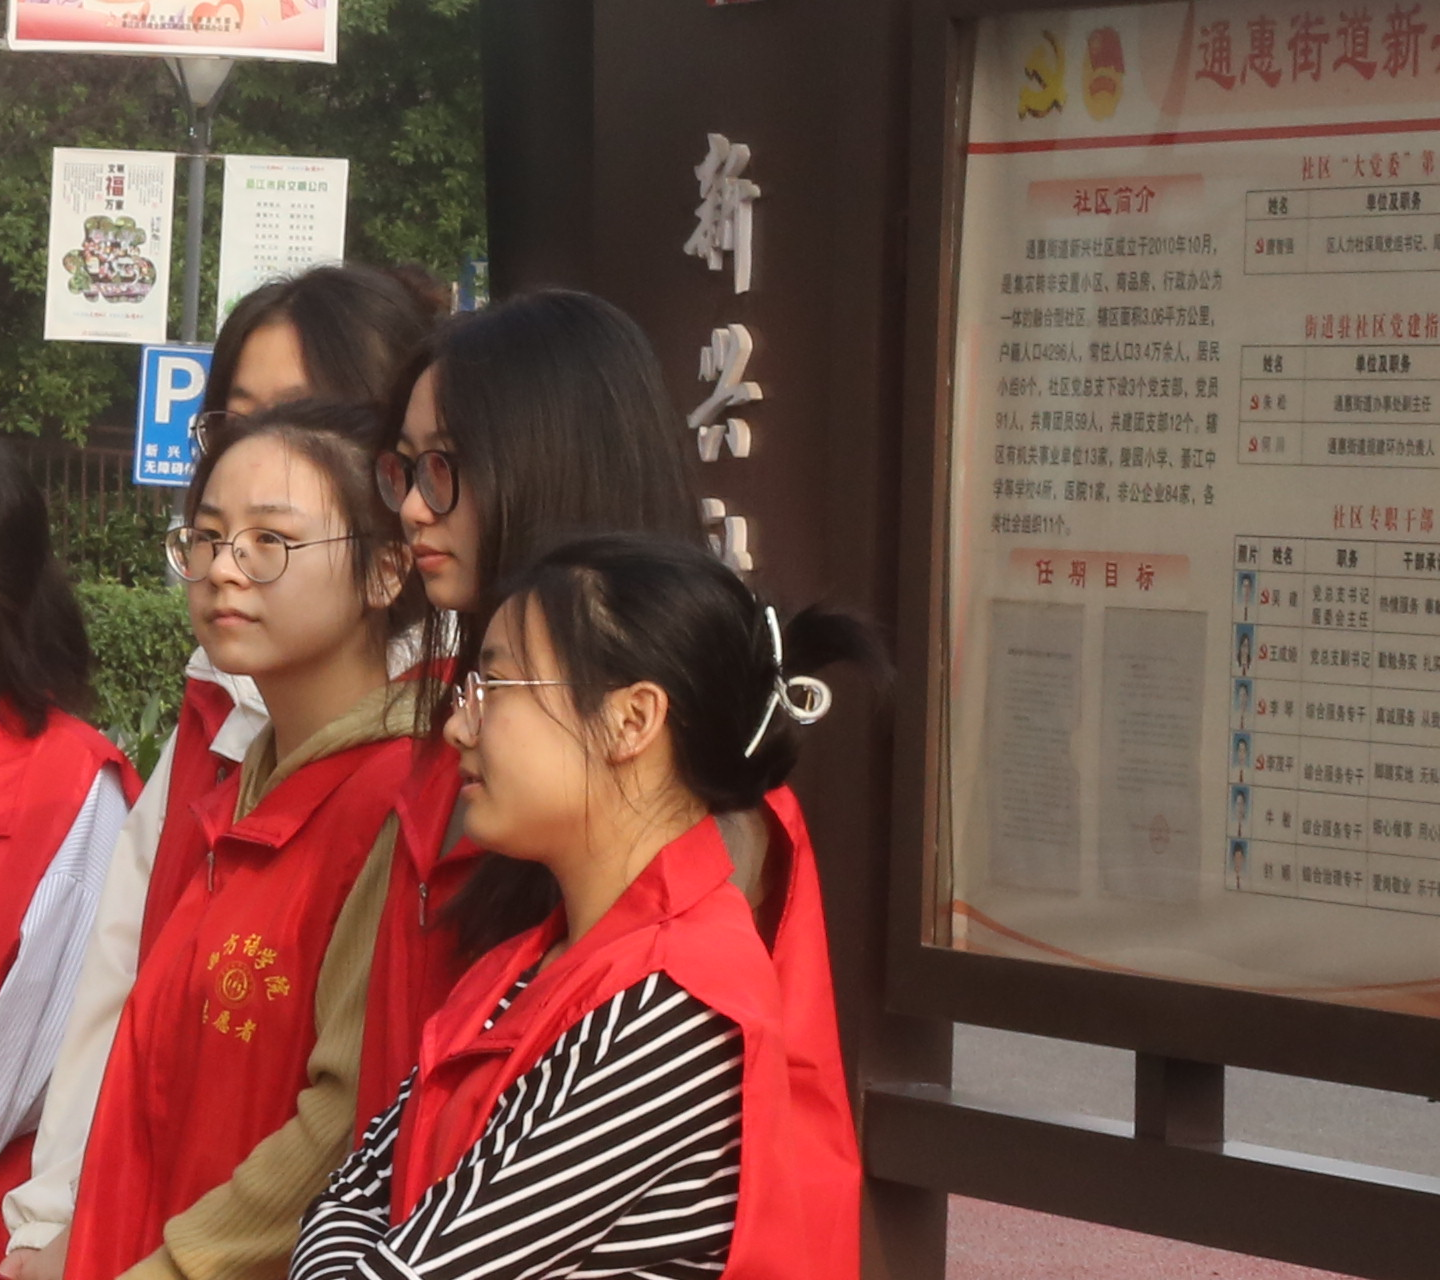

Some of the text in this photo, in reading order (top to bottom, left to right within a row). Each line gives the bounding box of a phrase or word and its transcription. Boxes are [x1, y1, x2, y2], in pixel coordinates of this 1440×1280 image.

[1195, 2, 1440, 92] 通惠街道新
[105, 175, 126, 198] 福
[1072, 185, 1157, 216] 社区简介
[1267, 190, 1422, 215] 姓名 单位及职务
[1262, 353, 1411, 374] 姓名 单位及职务
[154, 355, 208, 424] P
[1332, 504, 1434, 532] 社区专职干部
[1272, 547, 1294, 567] 姓名
[1336, 549, 1359, 568] 职务
